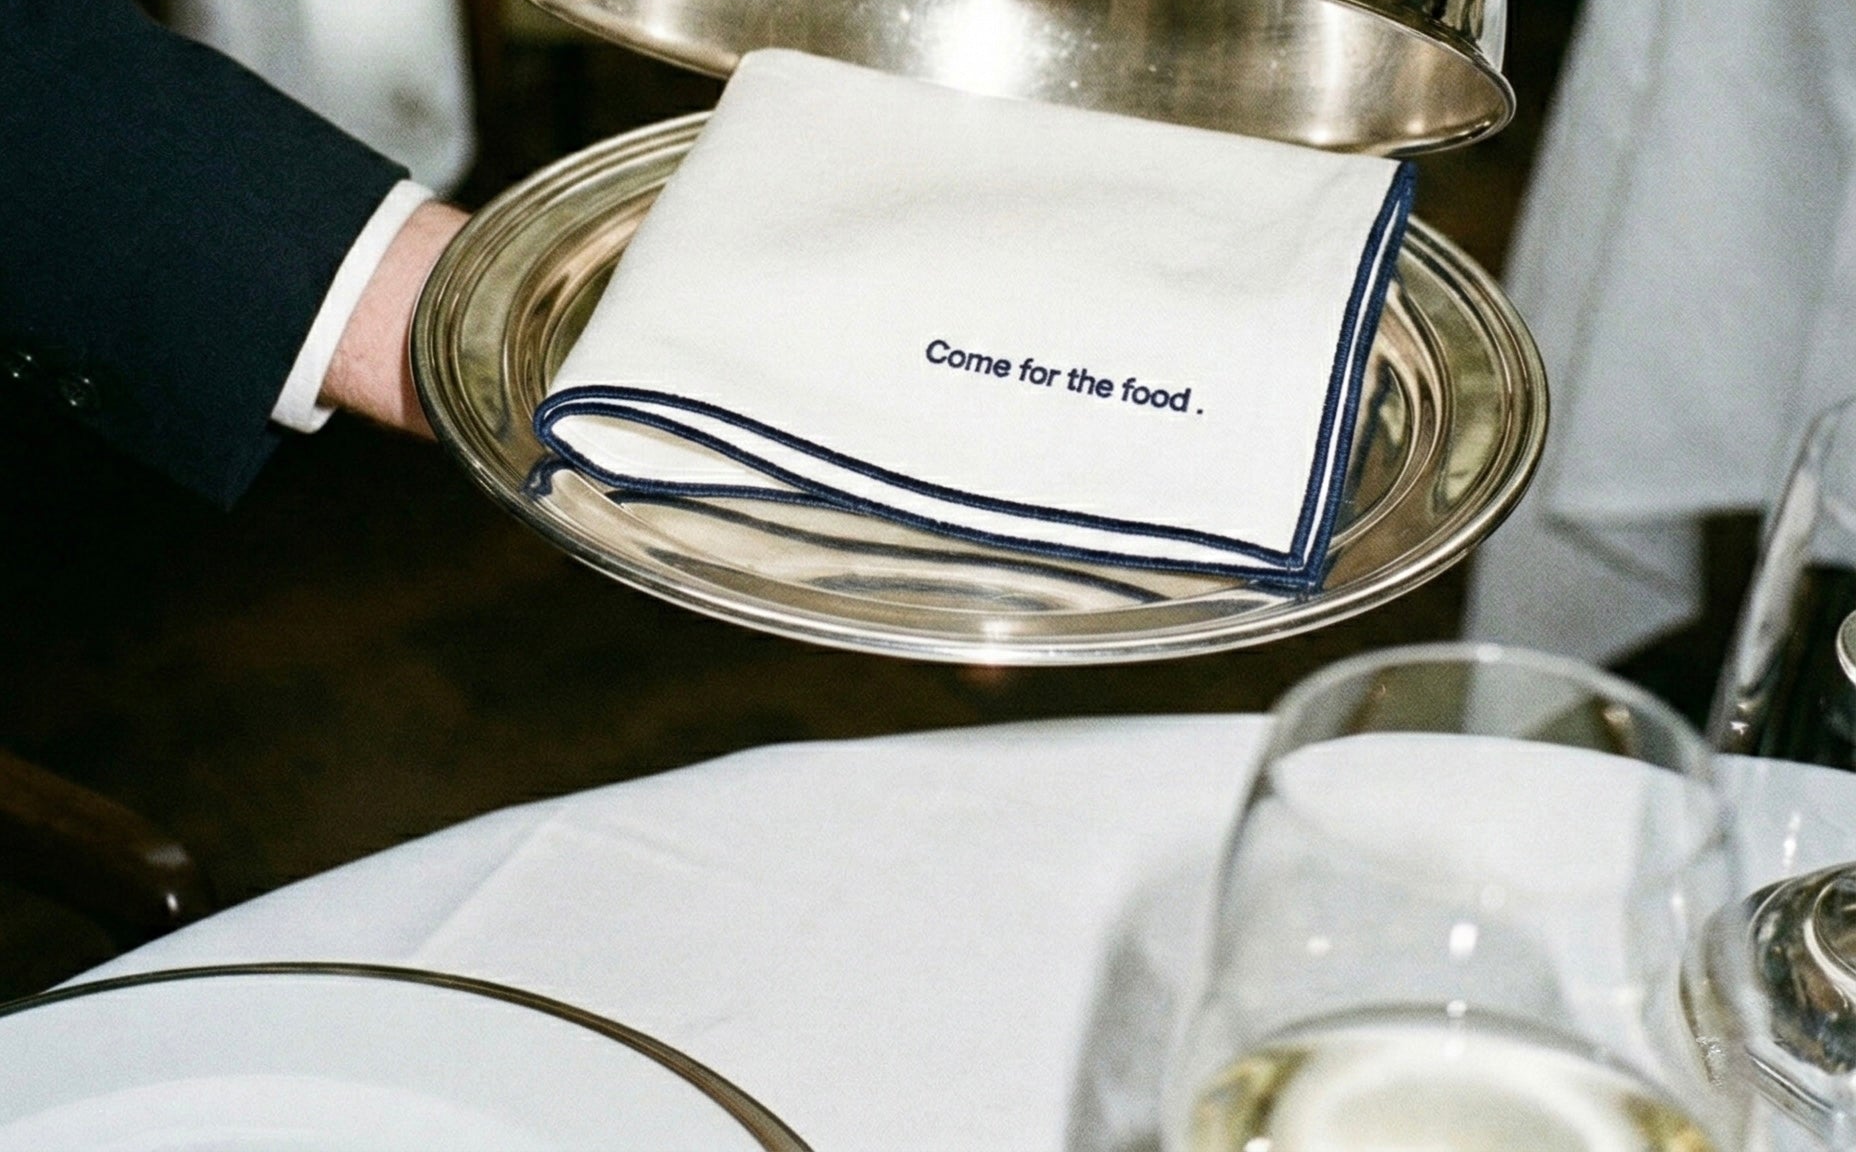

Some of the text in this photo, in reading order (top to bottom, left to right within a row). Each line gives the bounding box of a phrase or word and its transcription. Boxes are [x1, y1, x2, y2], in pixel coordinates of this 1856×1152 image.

[925, 339, 1012, 378] Come
[1019, 357, 1062, 387] for
[1067, 368, 1114, 399] the
